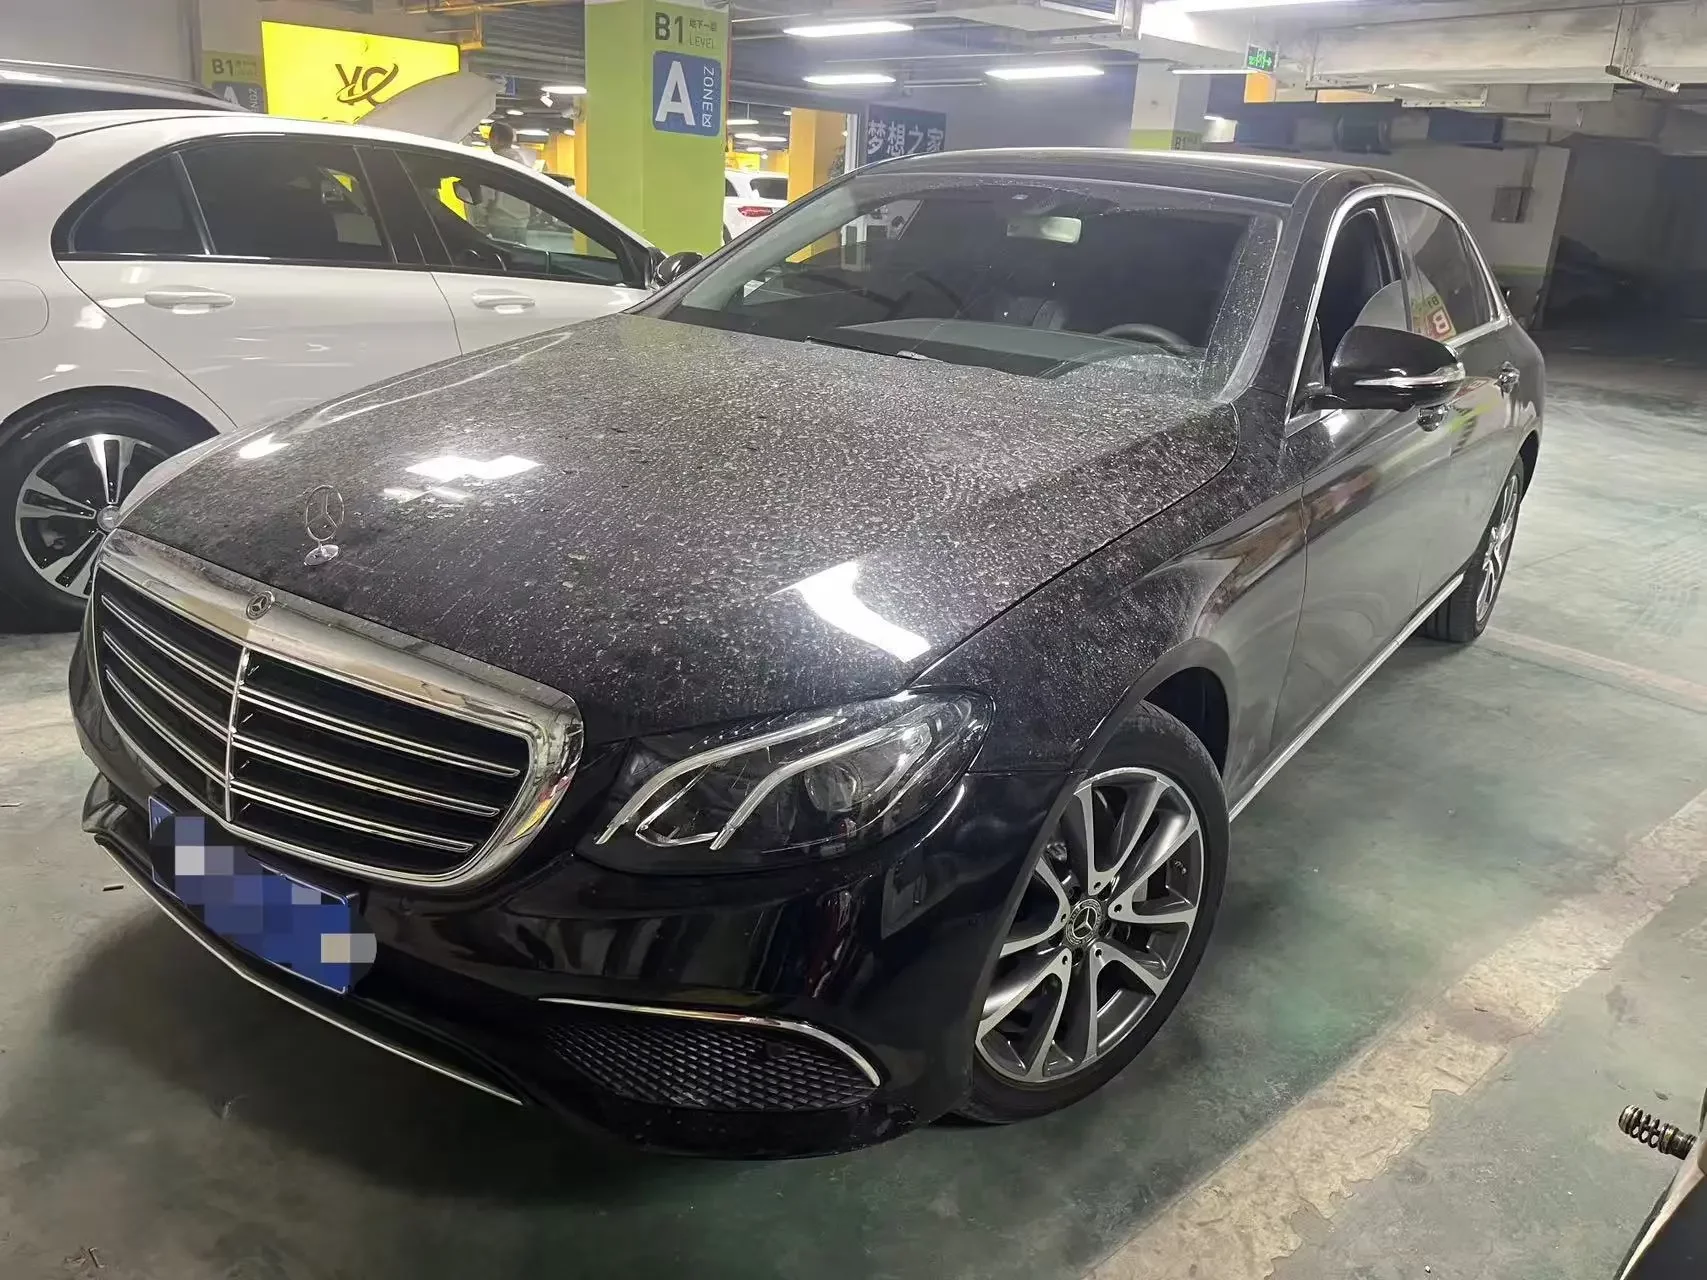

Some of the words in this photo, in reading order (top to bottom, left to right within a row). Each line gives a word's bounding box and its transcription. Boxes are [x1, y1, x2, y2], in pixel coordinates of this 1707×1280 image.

[654, 11, 683, 44] B1
[689, 33, 714, 49] LEVEL
[211, 58, 233, 77] B1
[655, 60, 696, 126] A
[867, 120, 944, 157] 梦想之家
